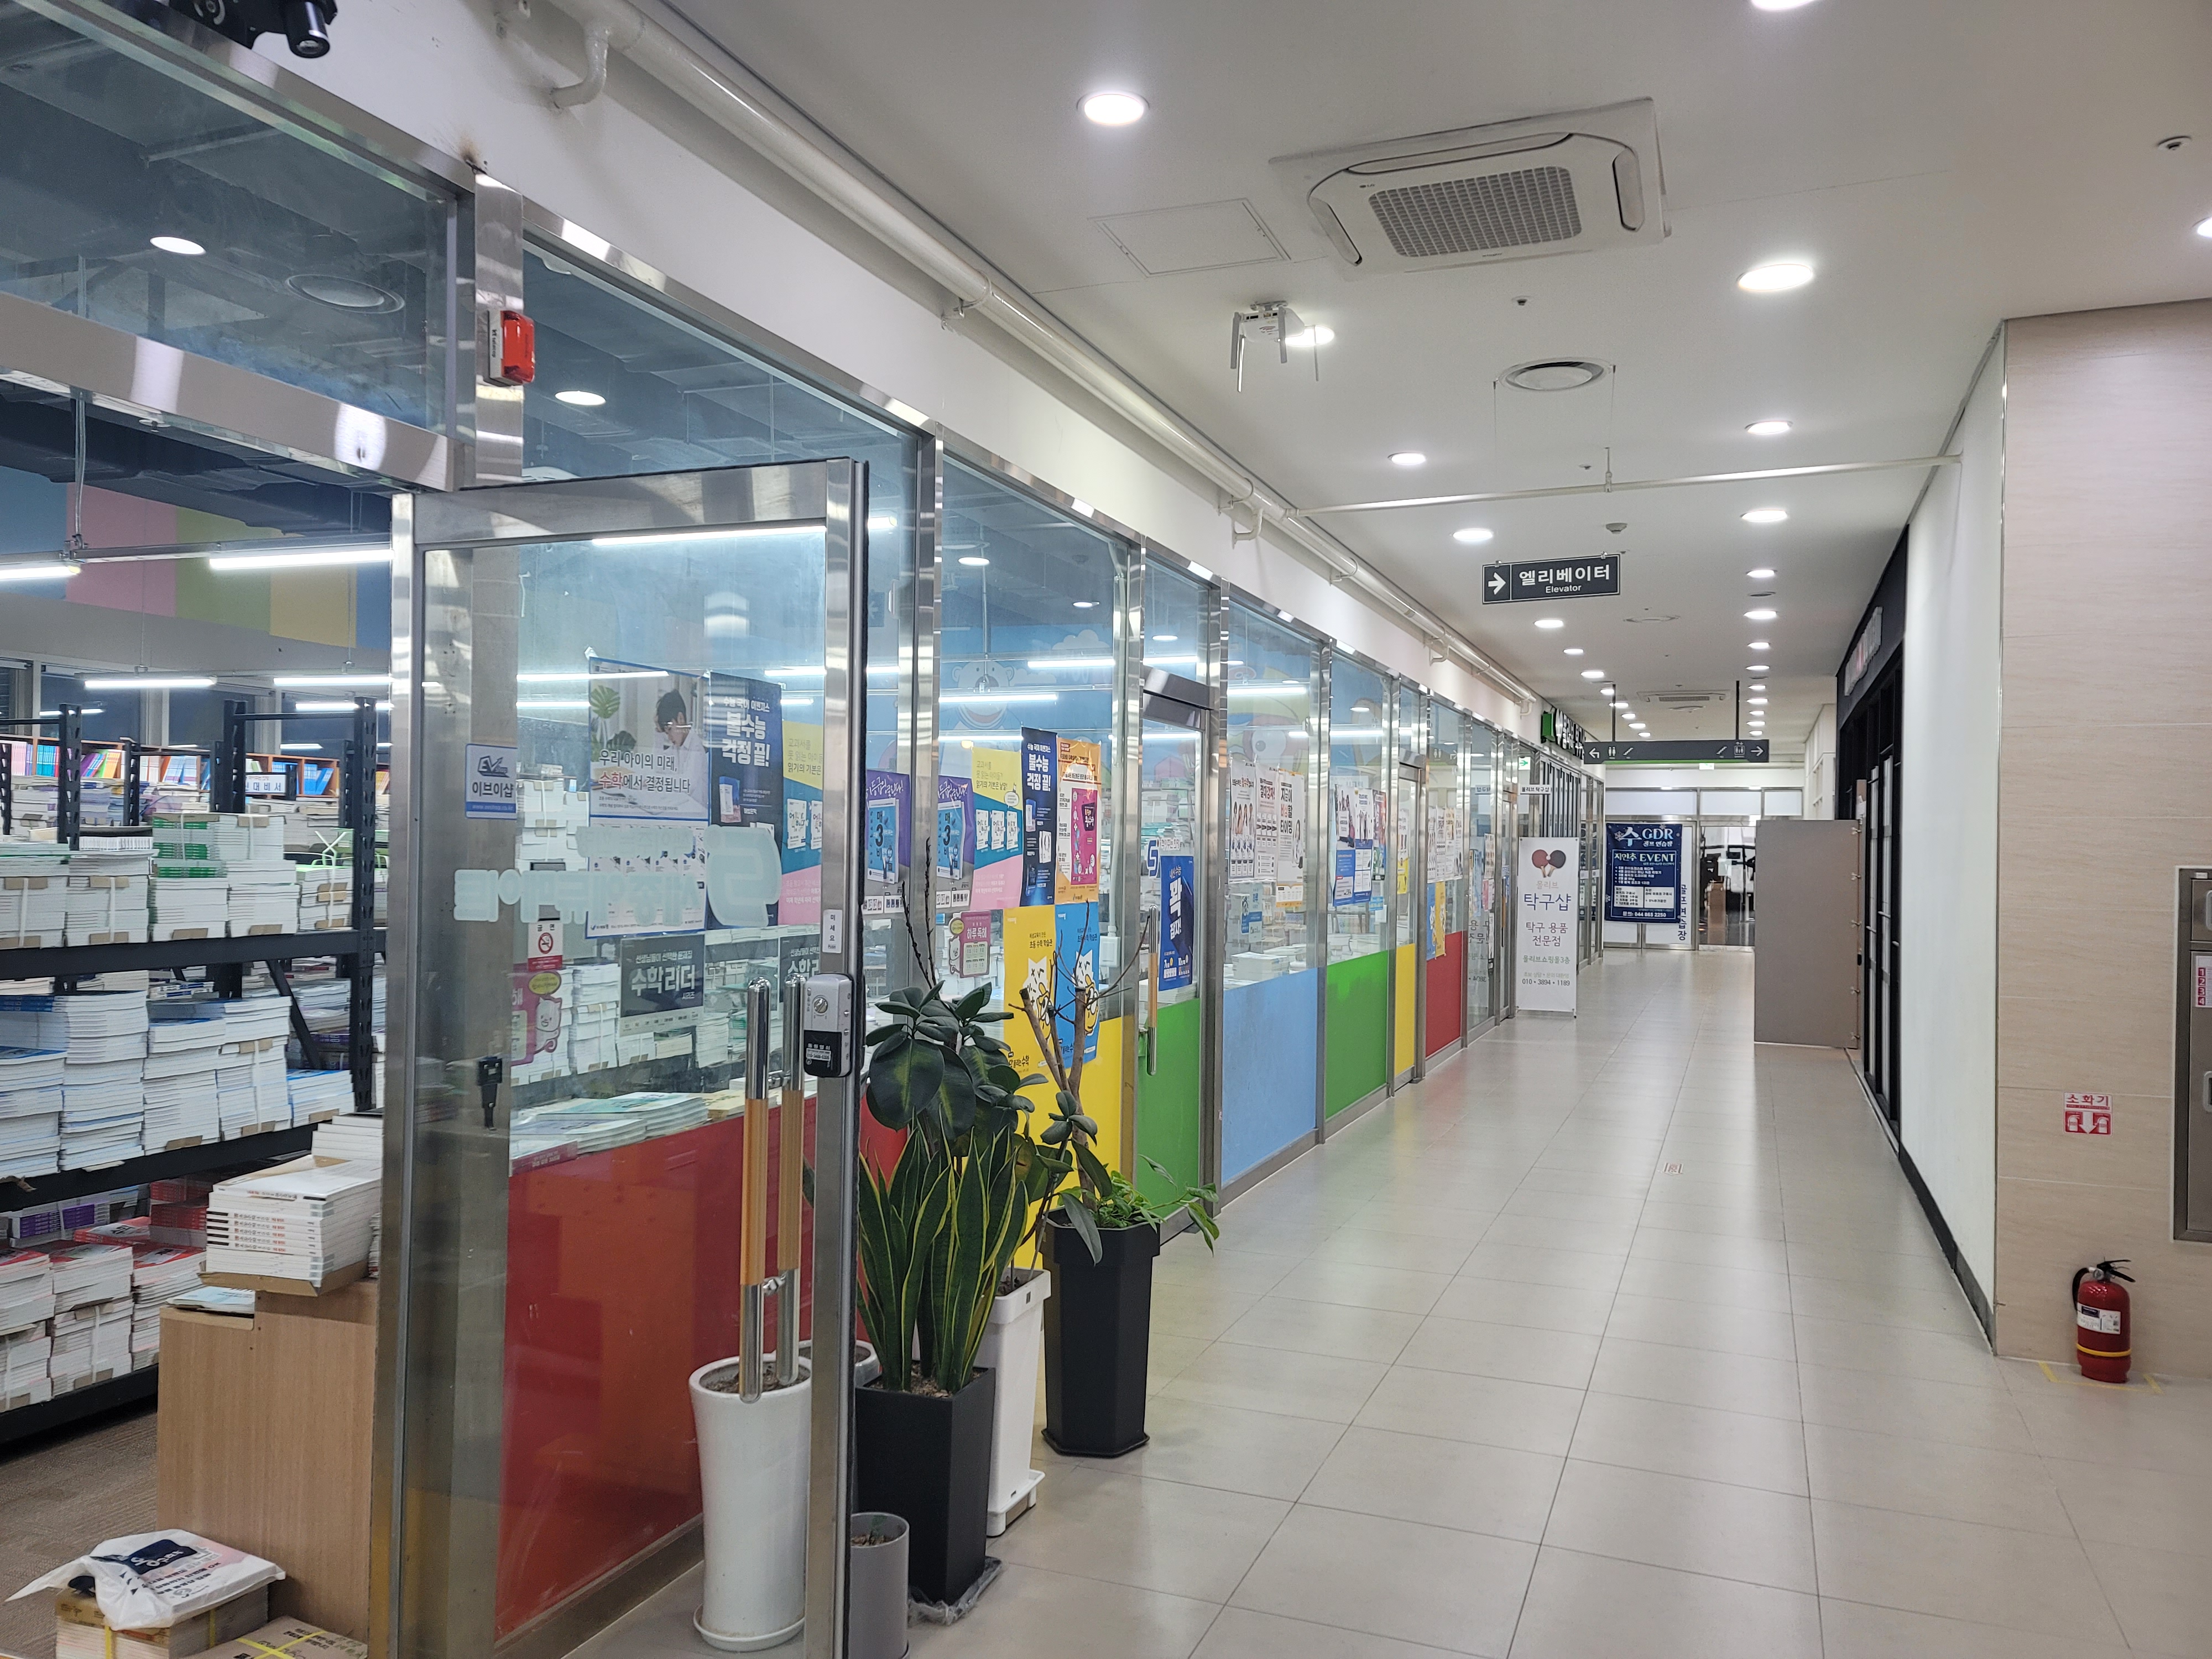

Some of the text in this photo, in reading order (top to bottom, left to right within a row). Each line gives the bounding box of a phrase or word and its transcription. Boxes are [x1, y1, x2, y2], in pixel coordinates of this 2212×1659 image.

[1519, 565, 1610, 586] 엘리베이터
[1546, 585, 1582, 593] Elevator
[727, 711, 766, 740] 불수능
[599, 749, 677, 772] 우리 아이의 미래,
[722, 738, 752, 765] 걱정
[787, 763, 821, 775] 읽기의 기본은
[1029, 753, 1049, 773] 불수능
[472, 781, 514, 798] 이브이샵
[599, 771, 690, 794] 수학에서 결정됩니다
[1027, 772, 1041, 790] 걱정
[1620, 827, 1674, 846] 수 GDR
[1640, 854, 1675, 862] EVENT
[1524, 893, 1572, 911] 탁구샵
[967, 927, 987, 940] 하루 독해
[1526, 922, 1568, 934] 탁구 용품
[1532, 936, 1561, 947] 전문점
[636, 952, 661, 964] 선생님들이
[662, 951, 677, 962] 선택한
[632, 964, 695, 997] 수학리더
[2066, 1094, 2109, 1106] 소화기
